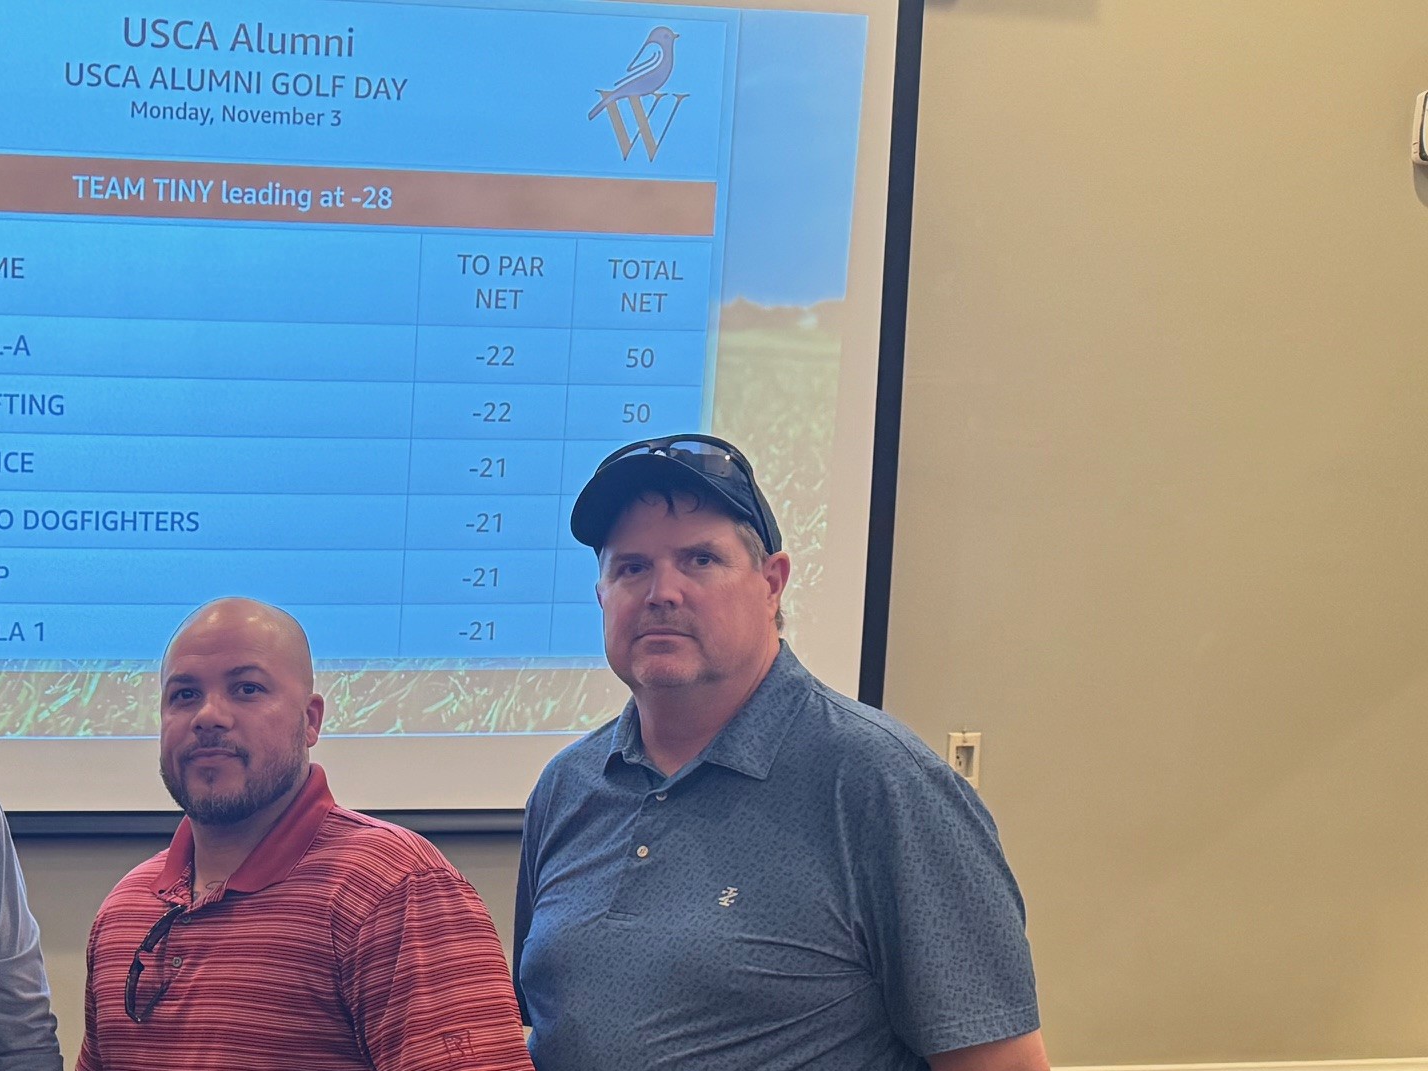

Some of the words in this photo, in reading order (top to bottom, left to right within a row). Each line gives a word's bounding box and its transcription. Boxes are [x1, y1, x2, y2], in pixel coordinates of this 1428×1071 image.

[123, 16, 218, 51] USCA
[230, 22, 354, 57] Alumni
[65, 62, 140, 89] USCA
[149, 67, 261, 94] ALUMNI
[272, 73, 345, 97] GOLF
[354, 76, 407, 101] DAY
[130, 101, 214, 126] Monday,
[222, 106, 324, 126] November
[331, 110, 342, 127] 3
[72, 175, 145, 200] TEAM
[153, 177, 213, 202] TINY
[221, 180, 311, 211] leading
[320, 186, 344, 207] at
[351, 186, 393, 209] -28
[457, 253, 491, 276] TO
[498, 255, 544, 277] PAR
[608, 258, 684, 282] TOTAL
[475, 288, 523, 311] NET
[620, 291, 668, 313] NET
[476, 346, 515, 366] -22
[626, 348, 655, 368] 50
[473, 403, 511, 422] -22
[622, 403, 650, 424] 50
[469, 458, 506, 478] -21
[23, 509, 199, 532] DOGFIGHTERS
[466, 513, 503, 533] -21
[462, 568, 500, 588] -21
[34, 621, 45, 642] 1
[459, 621, 496, 642] -21
